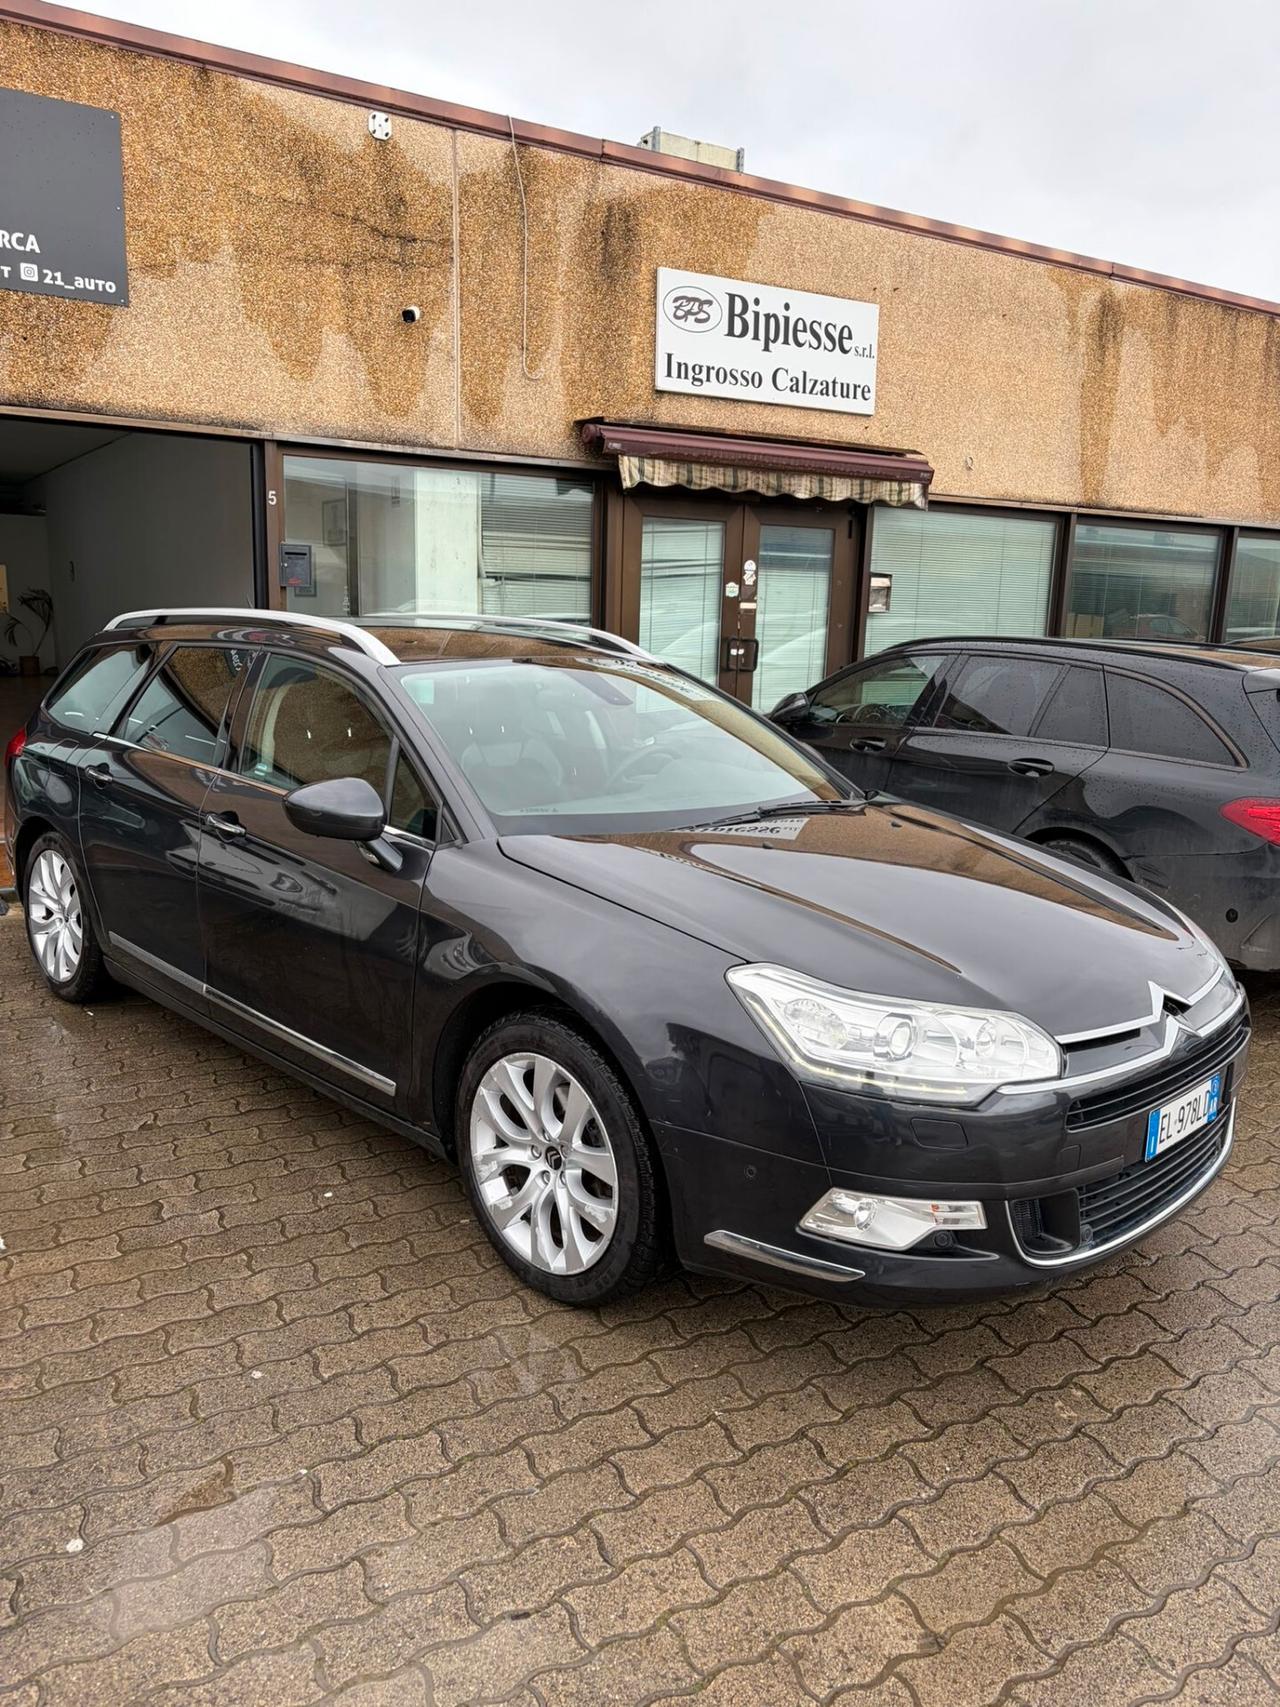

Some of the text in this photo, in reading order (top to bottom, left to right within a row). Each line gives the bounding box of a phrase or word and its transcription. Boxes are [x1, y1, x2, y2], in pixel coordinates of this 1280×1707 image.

[724, 292, 853, 355] Bipiesse
[854, 344, 875, 359] s.r.l.
[664, 352, 871, 400] Ingrosso Calzature
[268, 490, 277, 505] 5
[1159, 1111, 1172, 1144] EL
[1177, 1090, 1212, 1134] 978LD
